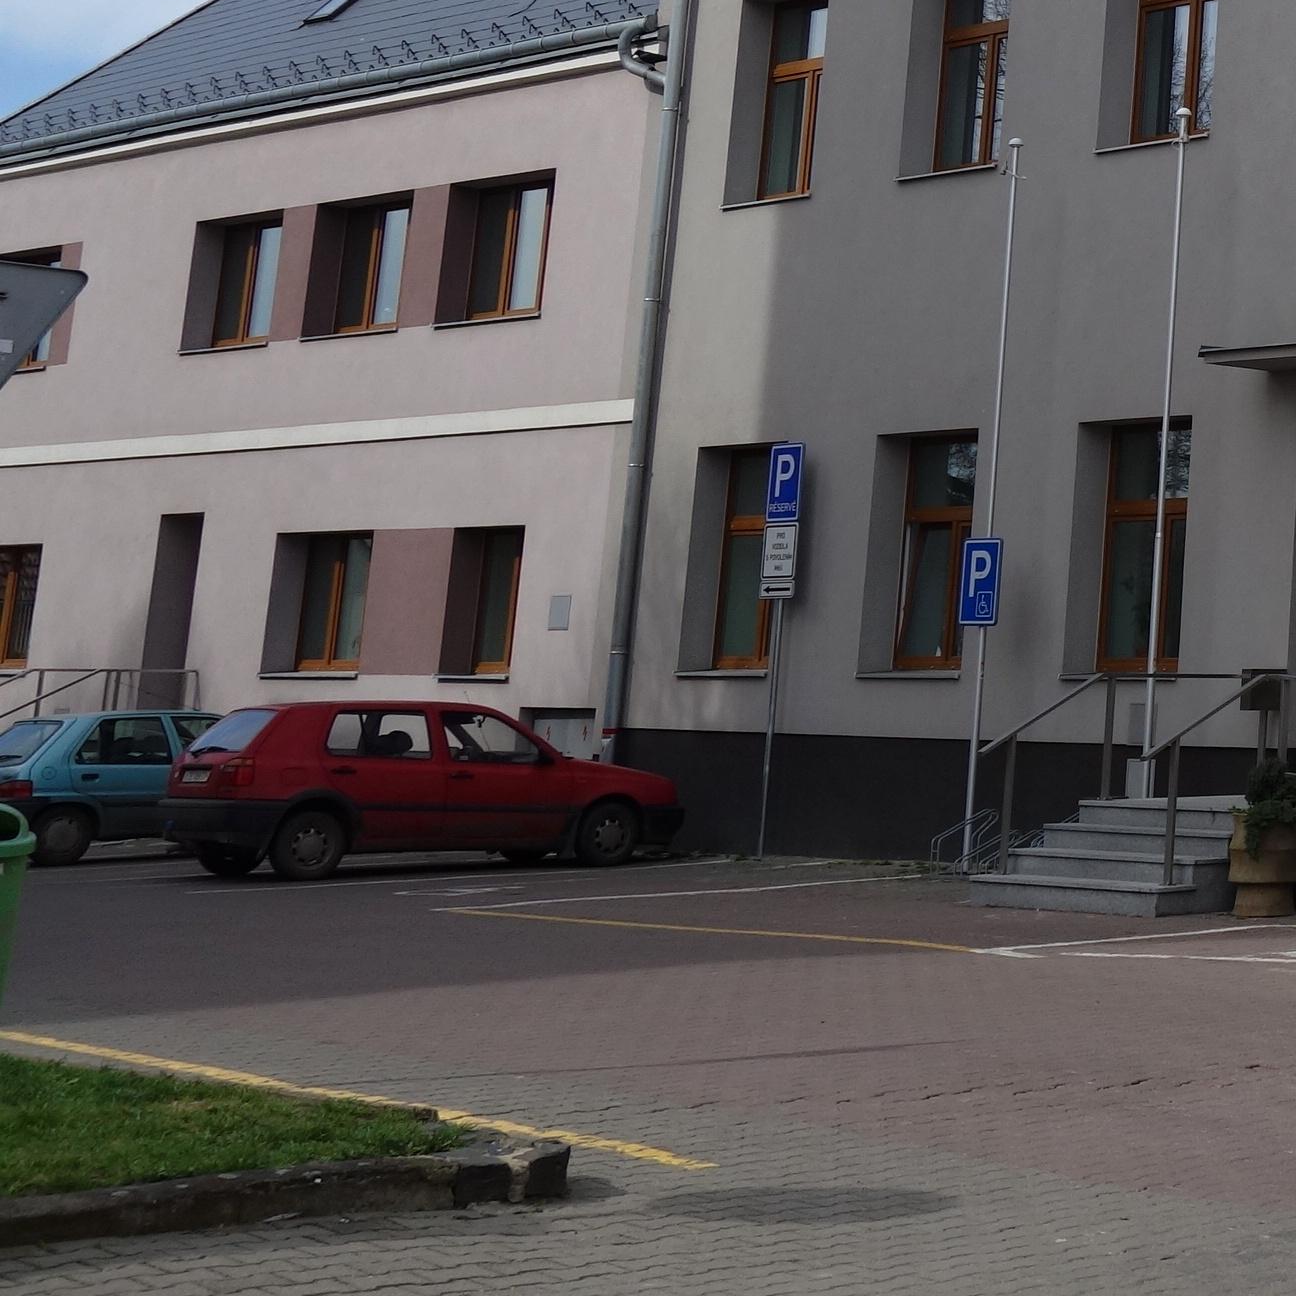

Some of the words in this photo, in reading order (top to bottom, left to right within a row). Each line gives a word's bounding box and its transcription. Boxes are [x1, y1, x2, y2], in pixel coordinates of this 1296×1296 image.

[774, 454, 795, 498] P
[769, 501, 796, 512] RÉSERVÉ
[968, 550, 992, 598] P
